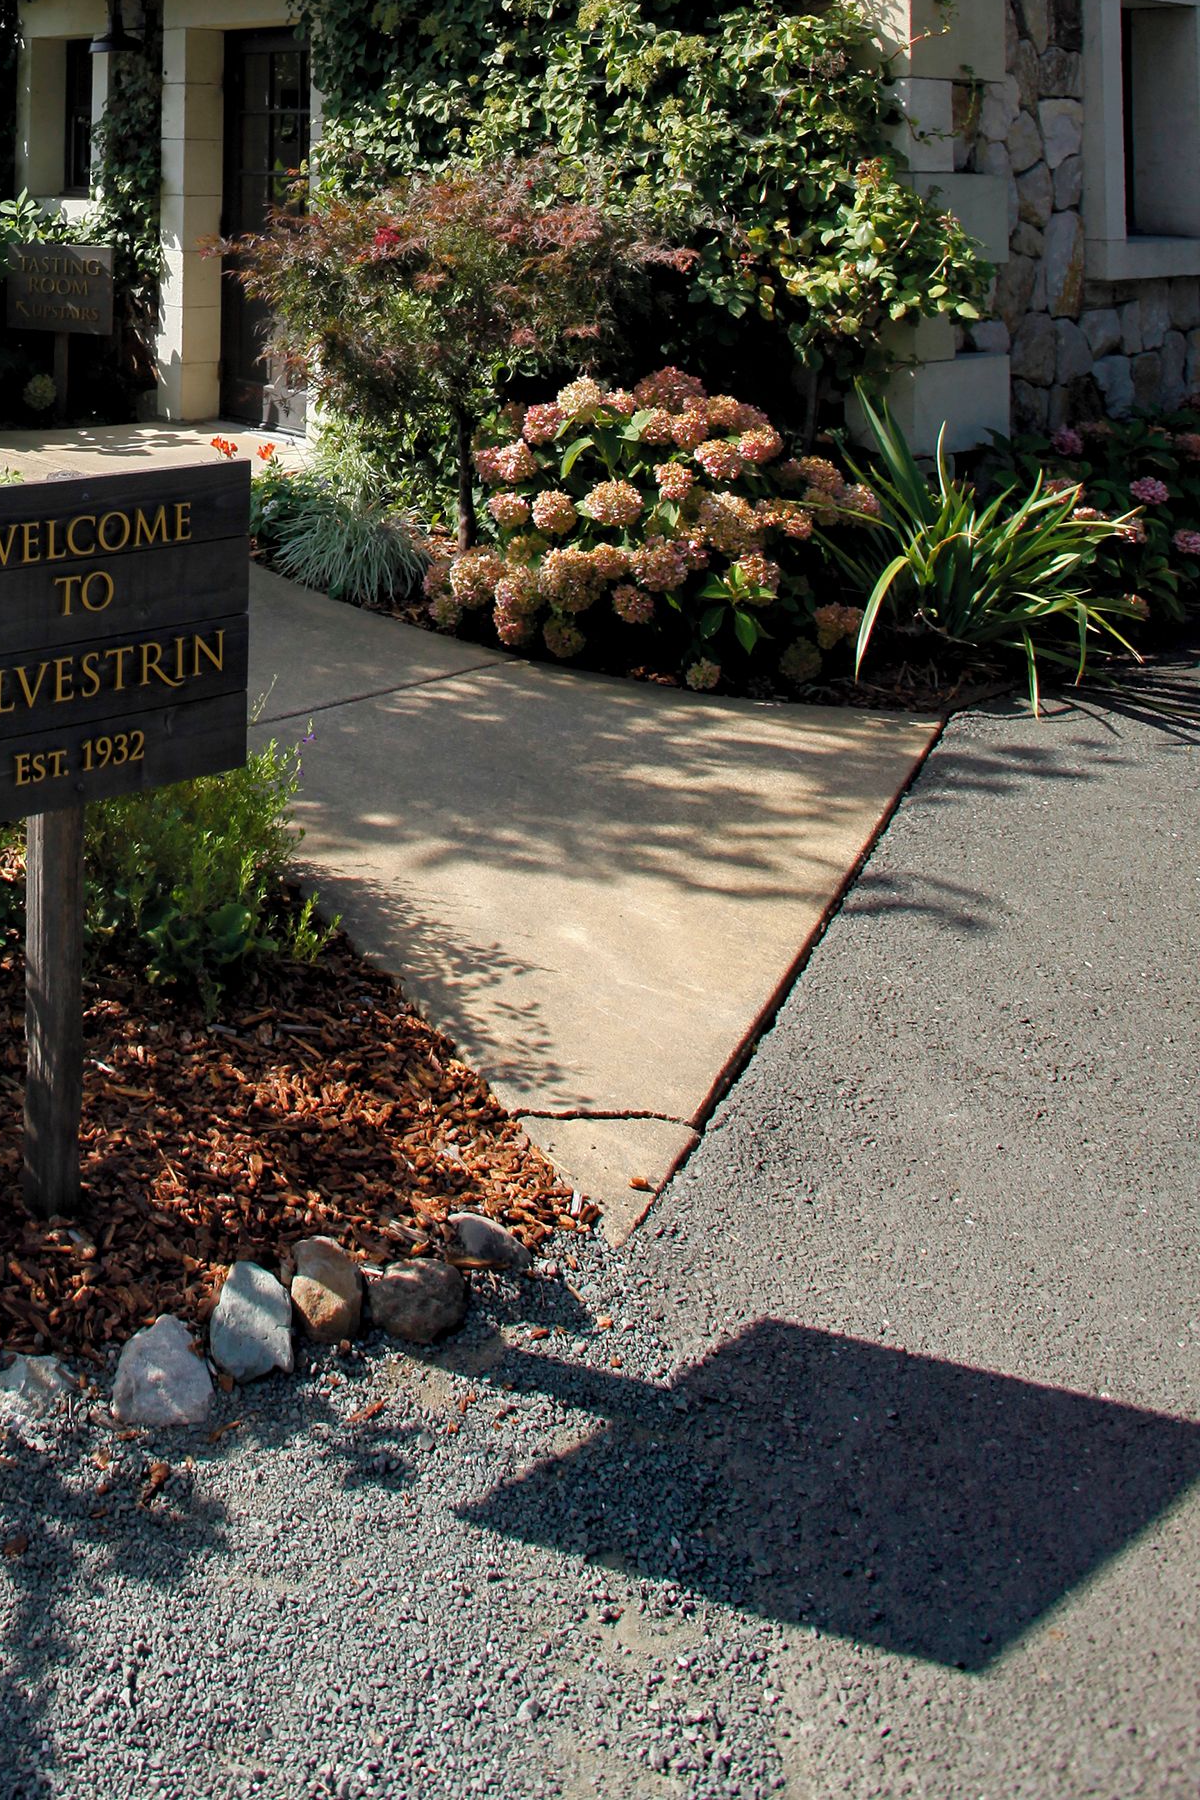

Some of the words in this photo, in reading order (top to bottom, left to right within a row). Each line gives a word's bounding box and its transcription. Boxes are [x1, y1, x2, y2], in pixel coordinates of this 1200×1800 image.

[20, 256, 100, 276] TASTING
[29, 277, 88, 296] ROOM
[55, 571, 115, 617] TO
[15, 749, 70, 787] EST.
[81, 730, 146, 773] 1932
